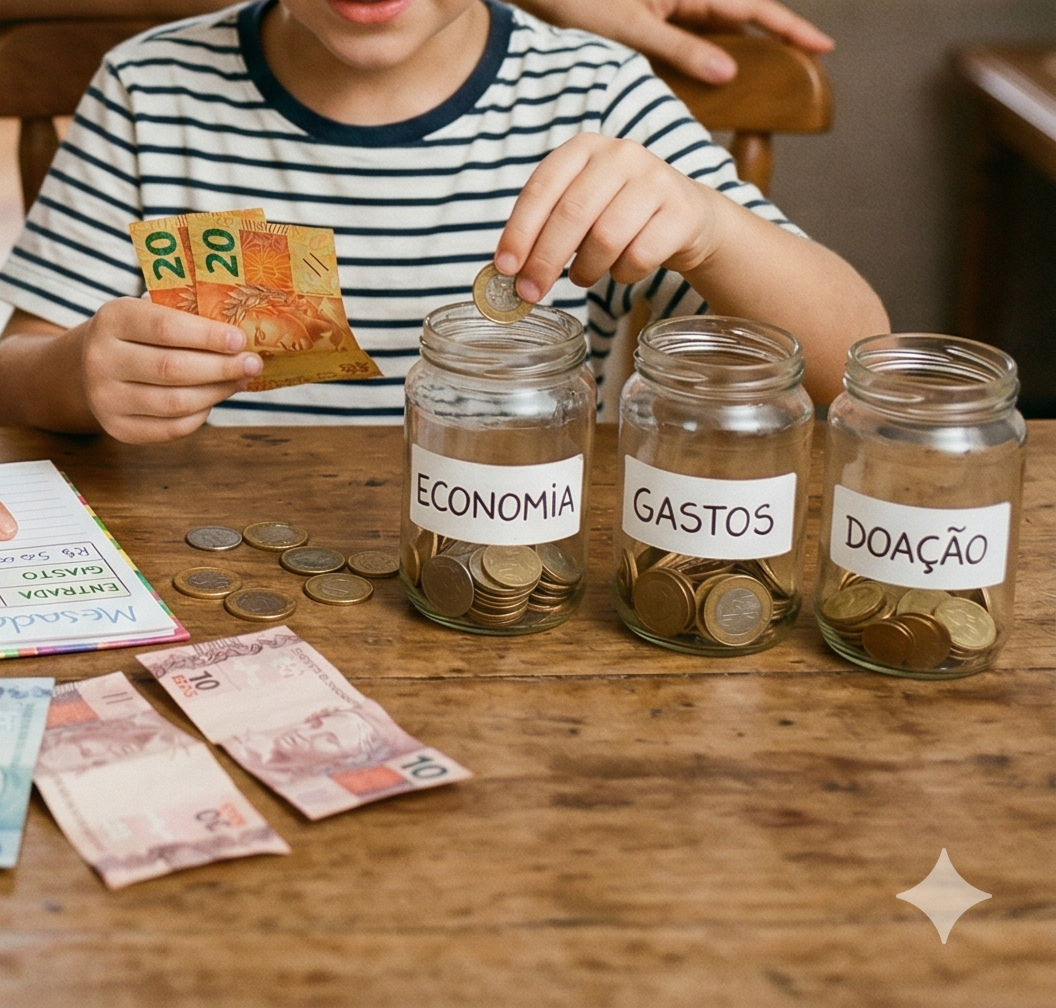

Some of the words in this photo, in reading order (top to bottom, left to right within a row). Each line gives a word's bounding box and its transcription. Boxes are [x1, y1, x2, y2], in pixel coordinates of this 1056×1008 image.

[145, 229, 186, 281] 20
[202, 227, 240, 278] 20
[632, 486, 775, 538] GASTOS
[845, 513, 989, 575] DOAÇÃO
[16, 582, 120, 600] ENTRADA
[189, 670, 221, 692] 10
[400, 753, 450, 780] 10
